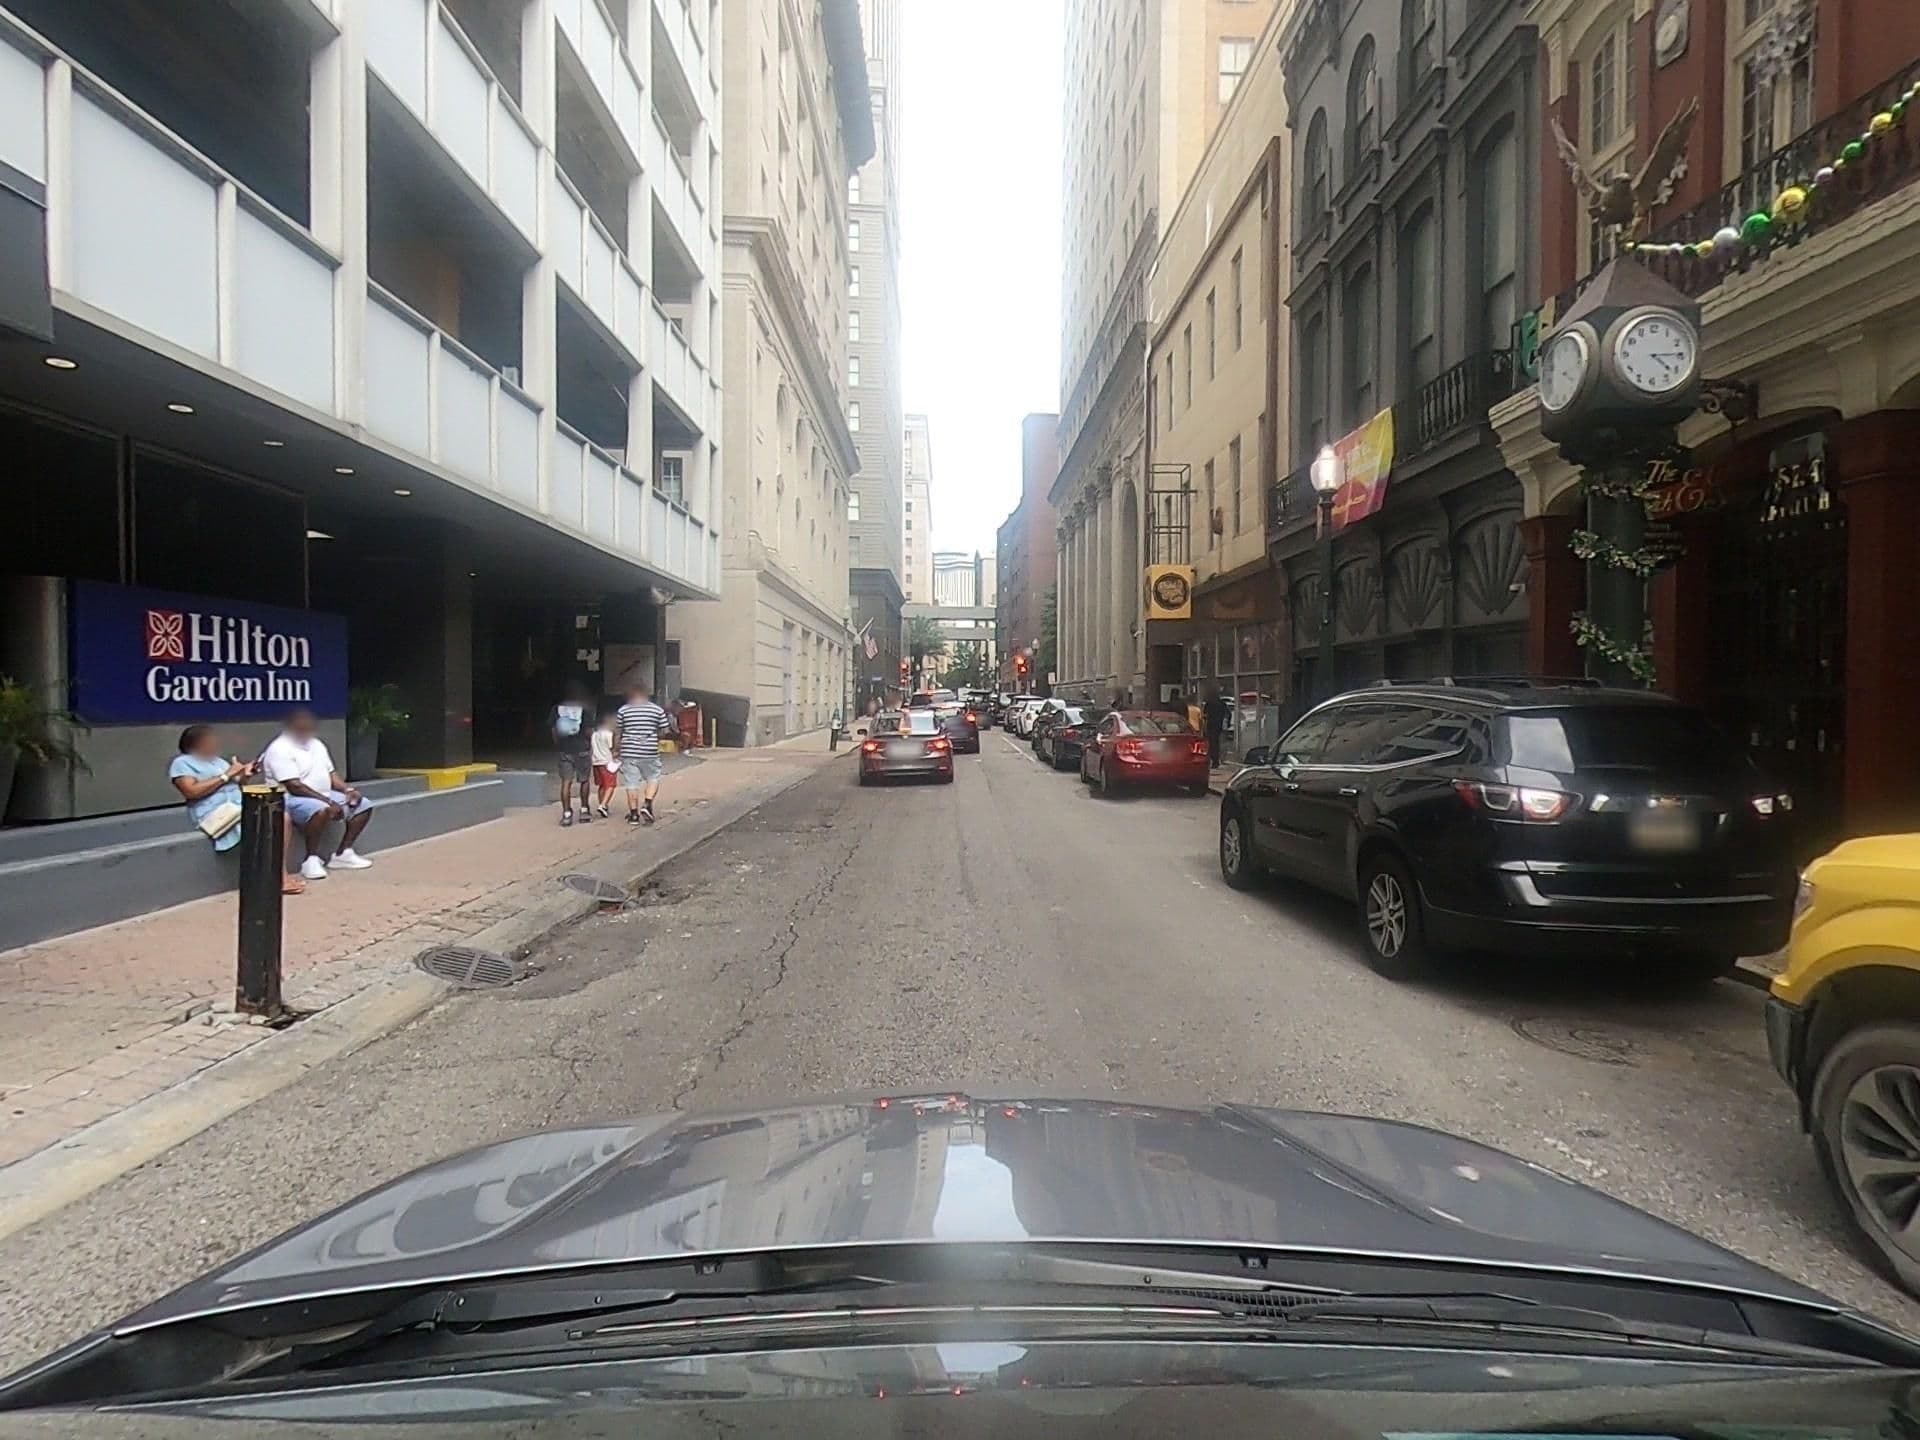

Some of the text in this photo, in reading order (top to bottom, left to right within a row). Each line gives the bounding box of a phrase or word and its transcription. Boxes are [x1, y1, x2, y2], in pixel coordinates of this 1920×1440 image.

[189, 613, 311, 668] Hilton
[146, 665, 312, 702] Garden Inn
